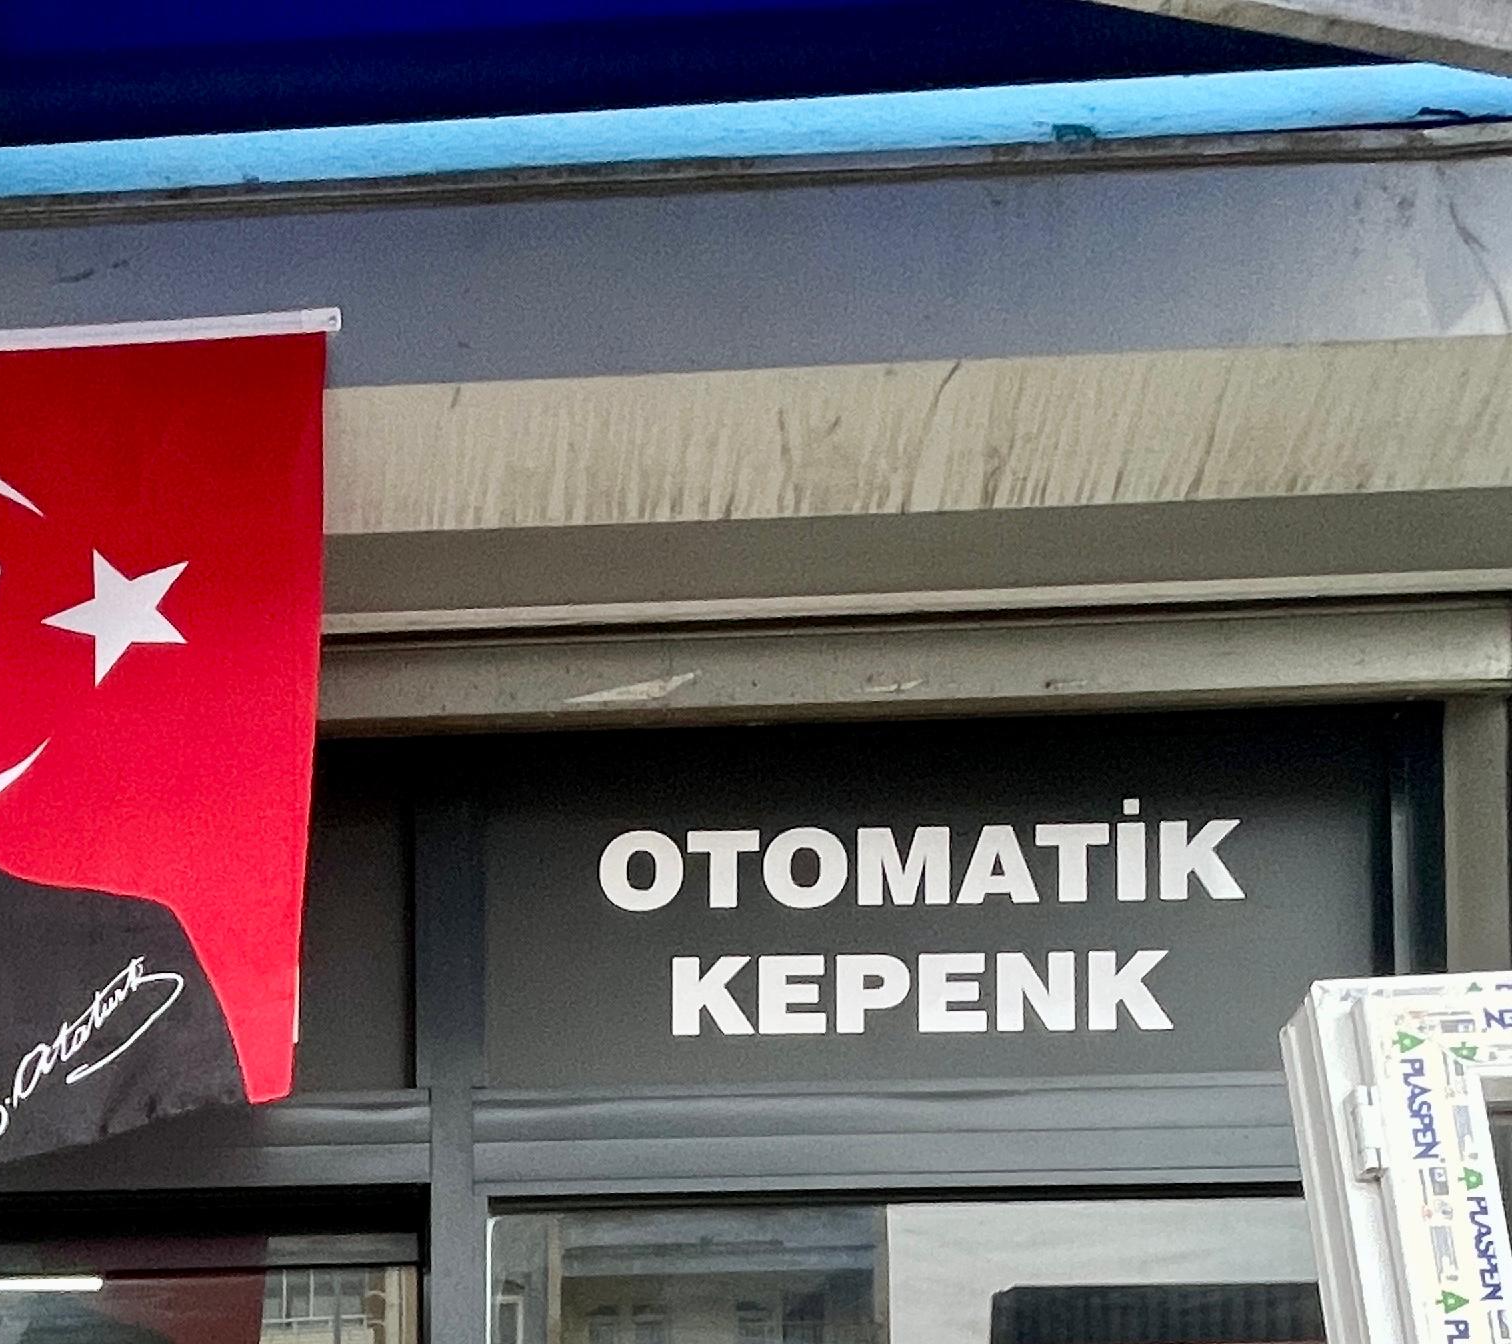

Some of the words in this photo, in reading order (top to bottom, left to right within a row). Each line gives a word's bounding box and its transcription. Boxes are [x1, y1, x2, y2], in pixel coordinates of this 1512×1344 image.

[600, 799, 1245, 911] OTOMATİK
[673, 950, 1173, 1035] KEPENK
[1399, 1058, 1441, 1160] PLASPEN
